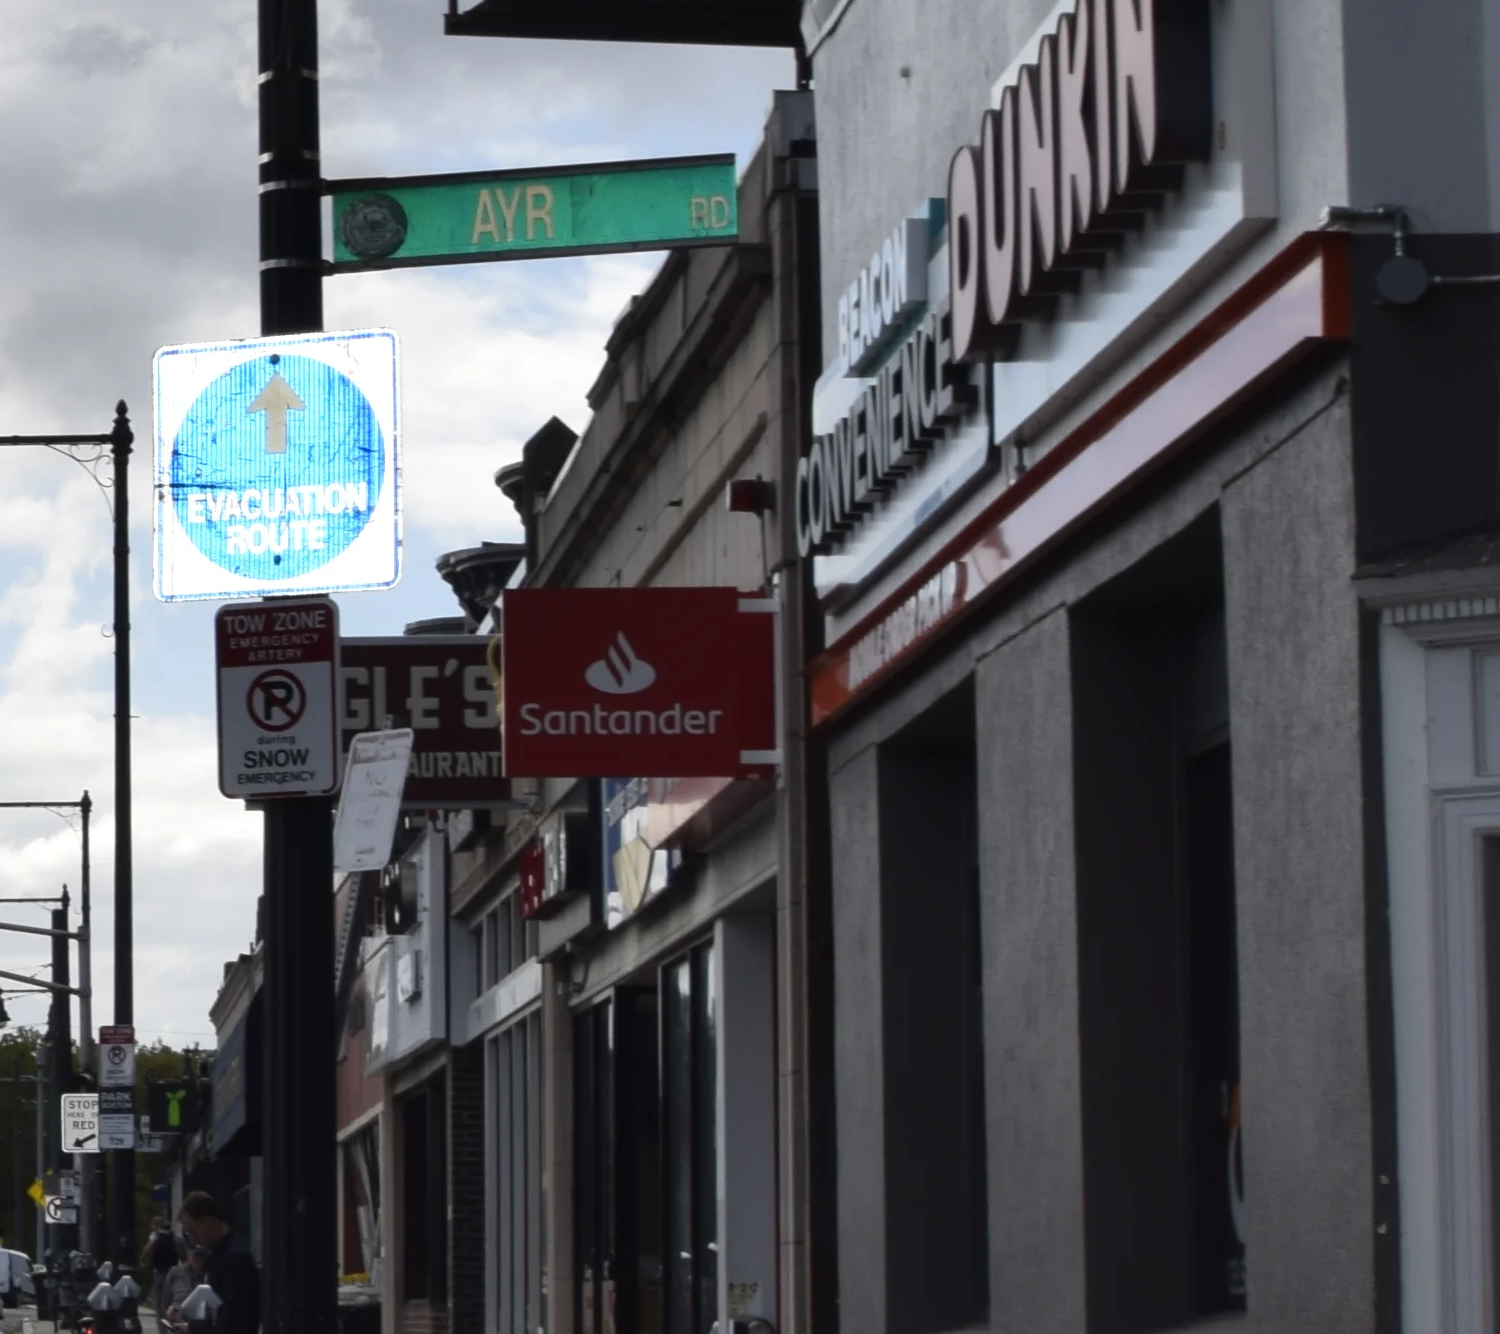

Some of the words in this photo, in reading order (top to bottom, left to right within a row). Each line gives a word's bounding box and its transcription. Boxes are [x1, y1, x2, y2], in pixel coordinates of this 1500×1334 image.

[470, 184, 556, 245] AYR
[689, 196, 730, 230] RD
[838, 216, 909, 378] BEACON
[795, 312, 954, 558] CONVENIENCE
[186, 481, 369, 525] EVACUATION
[225, 519, 327, 555] ROUTE
[224, 614, 266, 635] TOW
[273, 610, 327, 632] ZONE
[229, 633, 320, 650] EMERGENCY
[248, 648, 304, 662] ARTERY
[519, 701, 723, 736] Santander
[257, 734, 296, 746] during
[243, 747, 310, 769] SNOW
[236, 770, 317, 785] EMERGENCY
[68, 1100, 99, 1110] STOP
[72, 1120, 96, 1130] RED
